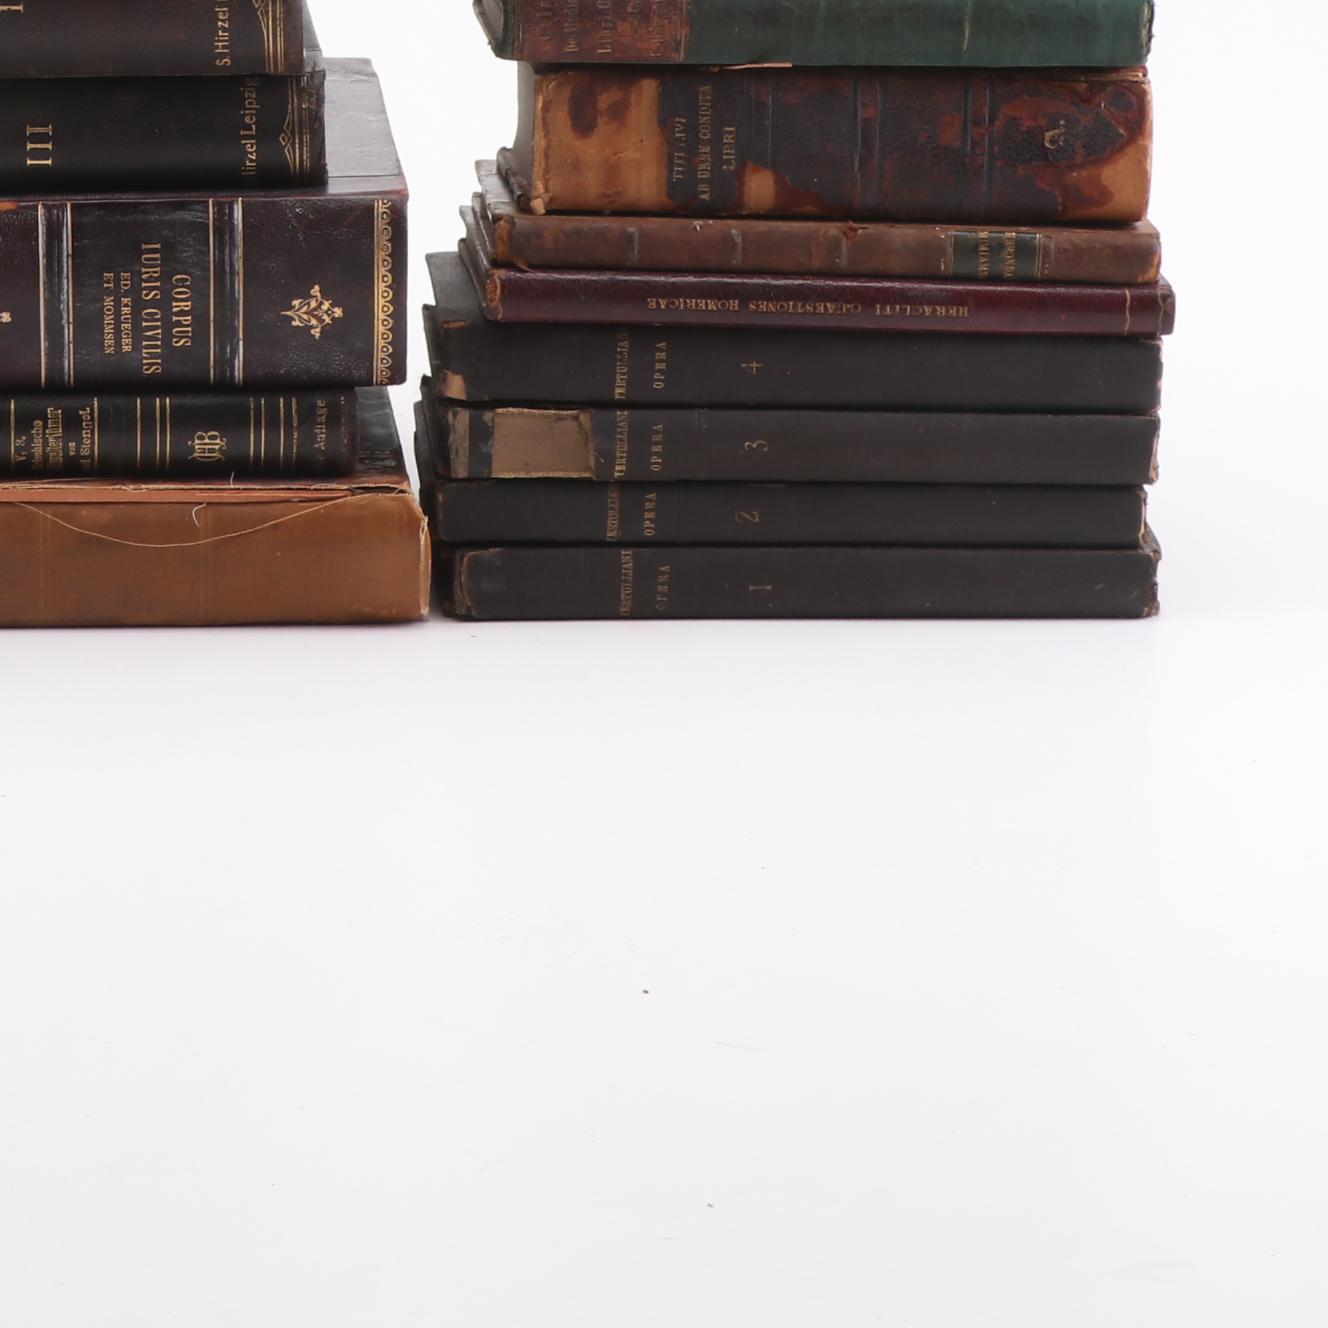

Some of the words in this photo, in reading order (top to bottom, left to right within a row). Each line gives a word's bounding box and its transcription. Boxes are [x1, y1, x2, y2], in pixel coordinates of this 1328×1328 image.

[213, 7, 230, 54] Hirzel
[698, 84, 712, 140] CONDITA
[25, 124, 53, 168] III
[240, 139, 257, 176] irzel
[721, 126, 737, 172] LIBRI
[698, 184, 711, 202] AB
[103, 272, 115, 290] ET
[120, 272, 132, 293] ED.
[140, 242, 162, 302] IURIS
[103, 295, 115, 354] MOMMSEN
[120, 297, 133, 353] KRUEGER
[171, 274, 192, 348] CORPUS
[646, 297, 741, 312] HOMERICAE
[874, 303, 969, 318] HERACLITI
[653, 341, 667, 390] OPERA
[740, 360, 764, 376] 4
[649, 424, 664, 472] OPERA
[743, 439, 768, 453] 3
[643, 492, 657, 536] OPERA
[734, 511, 760, 524] 2
